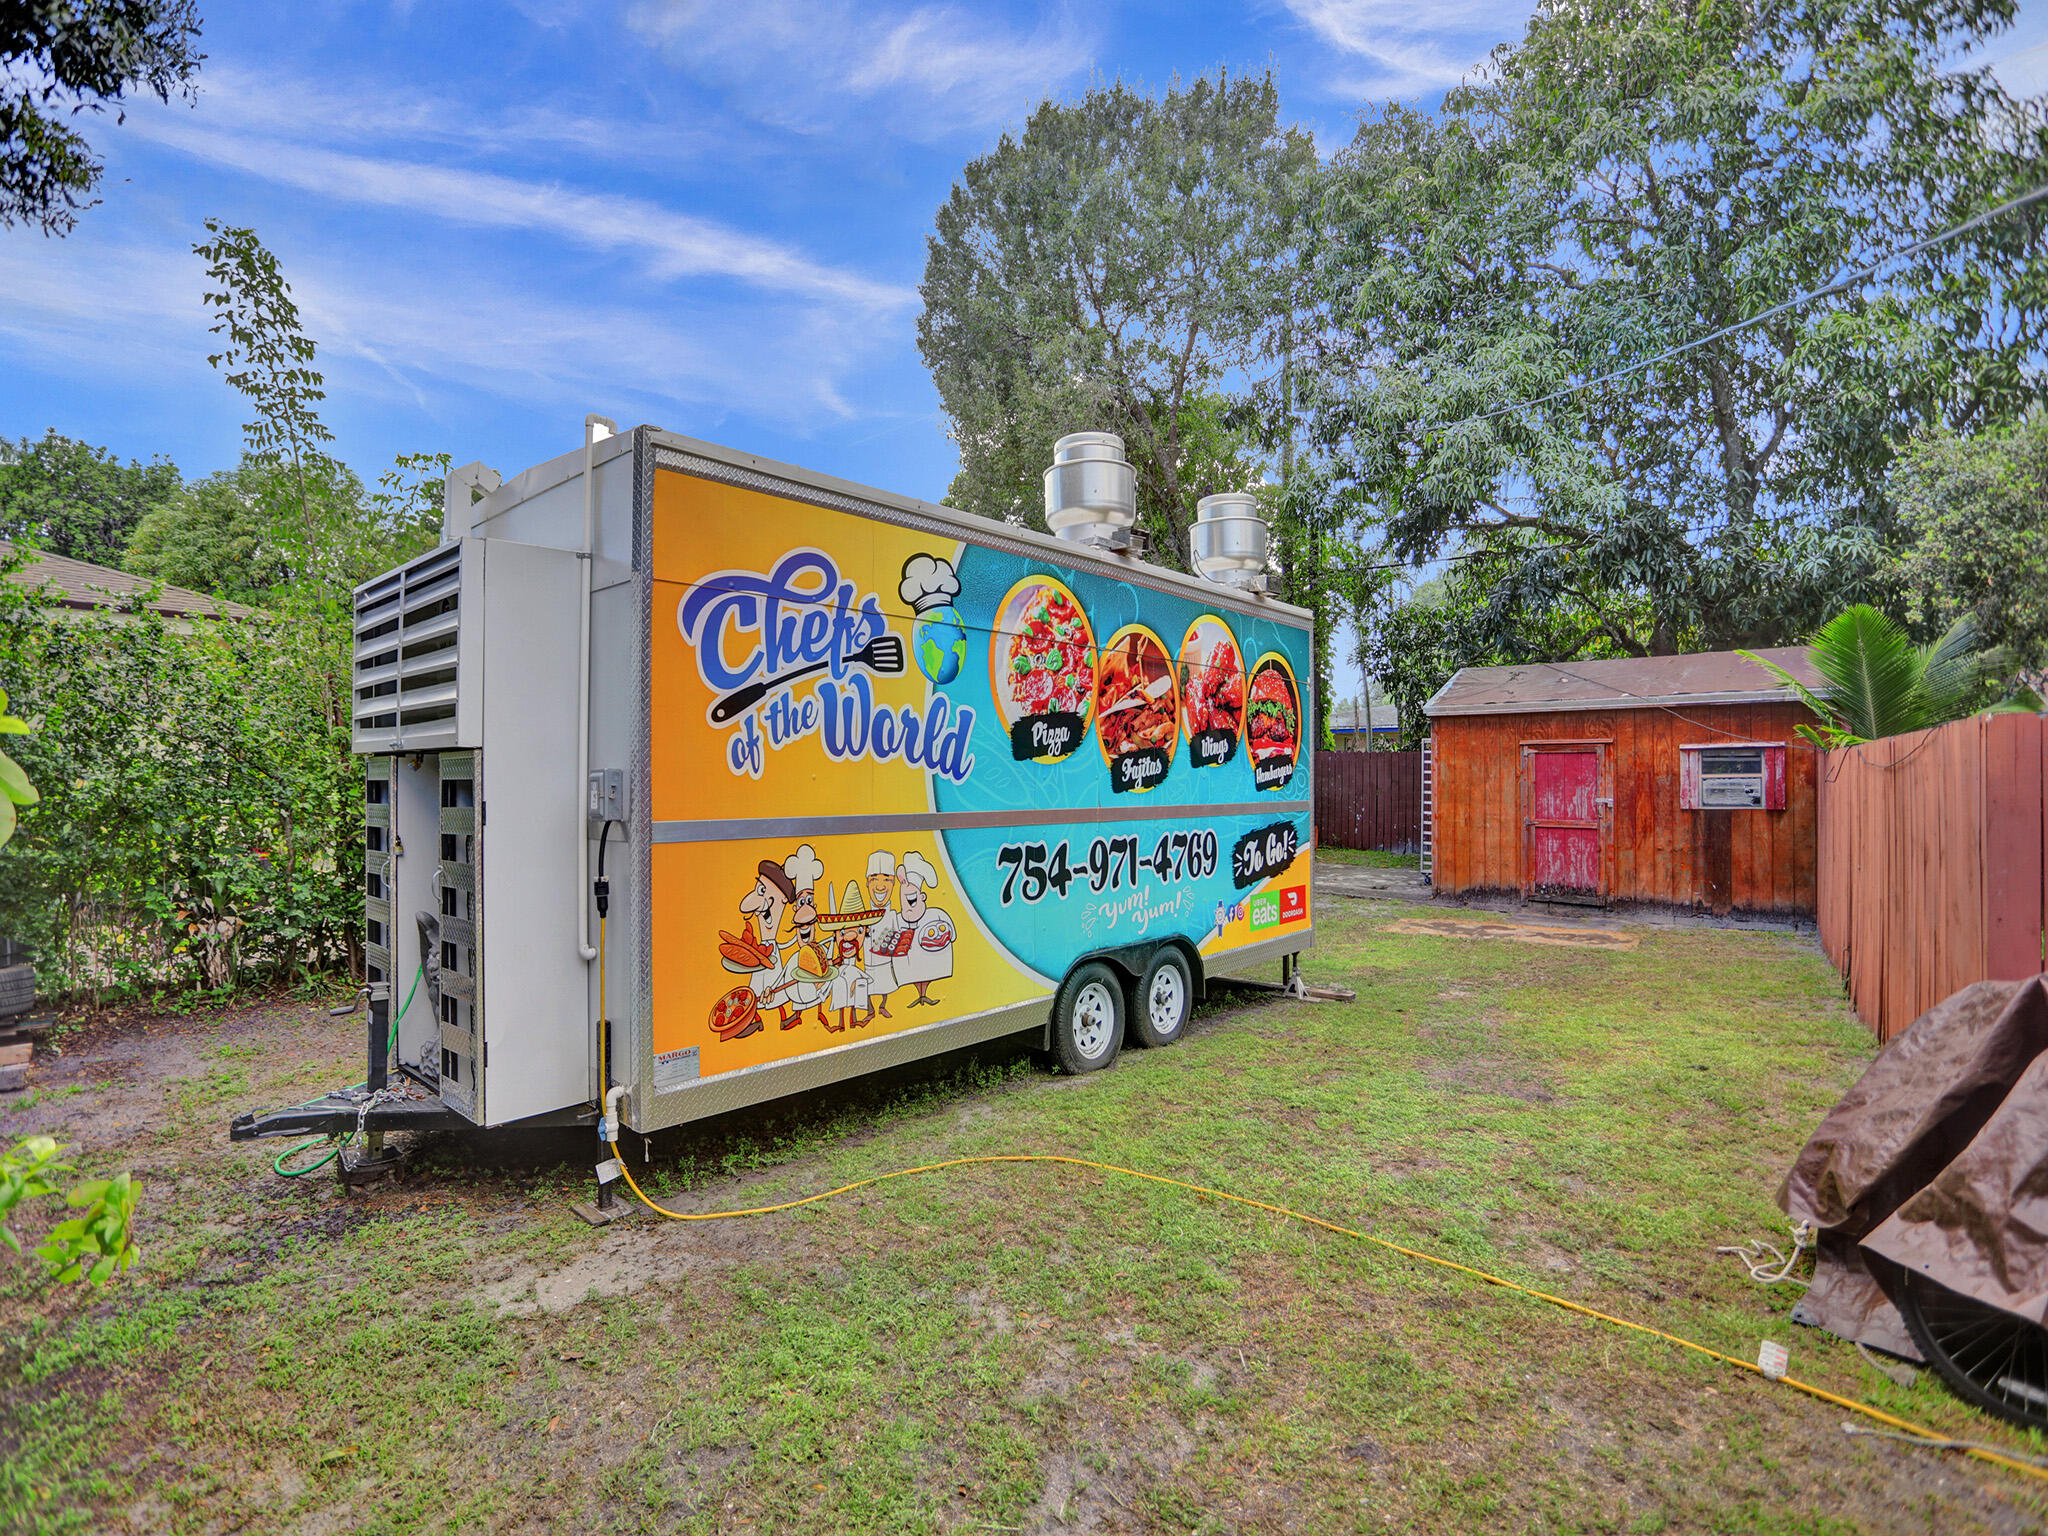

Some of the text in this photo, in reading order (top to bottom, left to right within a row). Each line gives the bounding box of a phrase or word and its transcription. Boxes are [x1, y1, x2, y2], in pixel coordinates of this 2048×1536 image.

[681, 551, 886, 690] Chefs
[731, 674, 975, 780] of the World
[1031, 721, 1071, 756] Pizza
[1201, 736, 1229, 763] Wings
[1121, 756, 1163, 788] Fajitas
[1256, 763, 1293, 784] Hamburgers
[997, 829, 1218, 907] 754-971-4769
[1243, 830, 1289, 876] To Go!
[1252, 902, 1278, 926] eats
